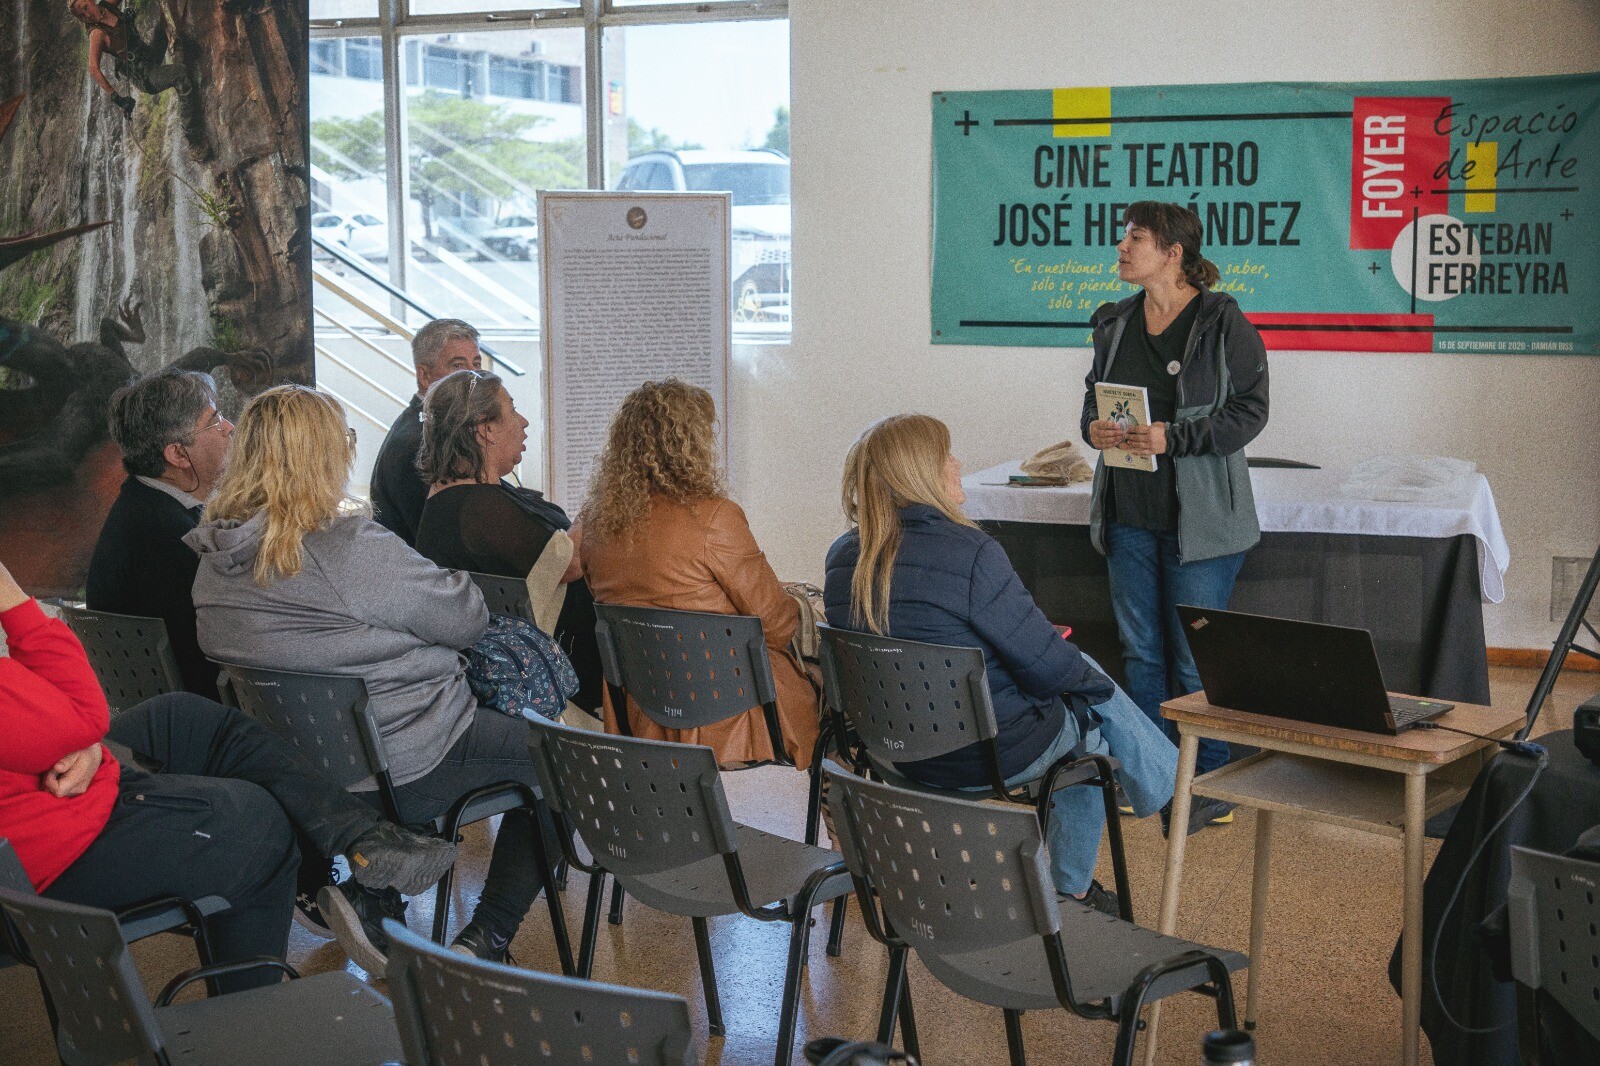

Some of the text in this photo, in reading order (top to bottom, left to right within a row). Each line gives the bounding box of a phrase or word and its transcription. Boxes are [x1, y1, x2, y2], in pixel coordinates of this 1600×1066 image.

[1433, 103, 1578, 147] Espacio
[1034, 140, 1259, 189] CINE TEATRO
[1362, 115, 1406, 218] FOYER
[1433, 139, 1578, 181] de Arte
[993, 188, 1301, 247] JOSÉ HENDEZ
[1429, 221, 1553, 256] ESTEBAN
[1037, 259, 1104, 274] cuestiones
[1225, 259, 1270, 279] saber,
[1427, 261, 1569, 295] FERREYRA
[1060, 281, 1073, 291] se
[1077, 278, 1122, 295] pierde
[1209, 277, 1255, 293] arda,
[1078, 298, 1091, 309] se
[1447, 341, 1456, 350] DE
[1457, 341, 1497, 350] SEPTIEMBRE
[1498, 341, 1507, 350] DE
[1508, 341, 1526, 350] 2020
[664, 705, 683, 717] 4114
[608, 842, 627, 858] 4111
[911, 917, 935, 940] 4115
